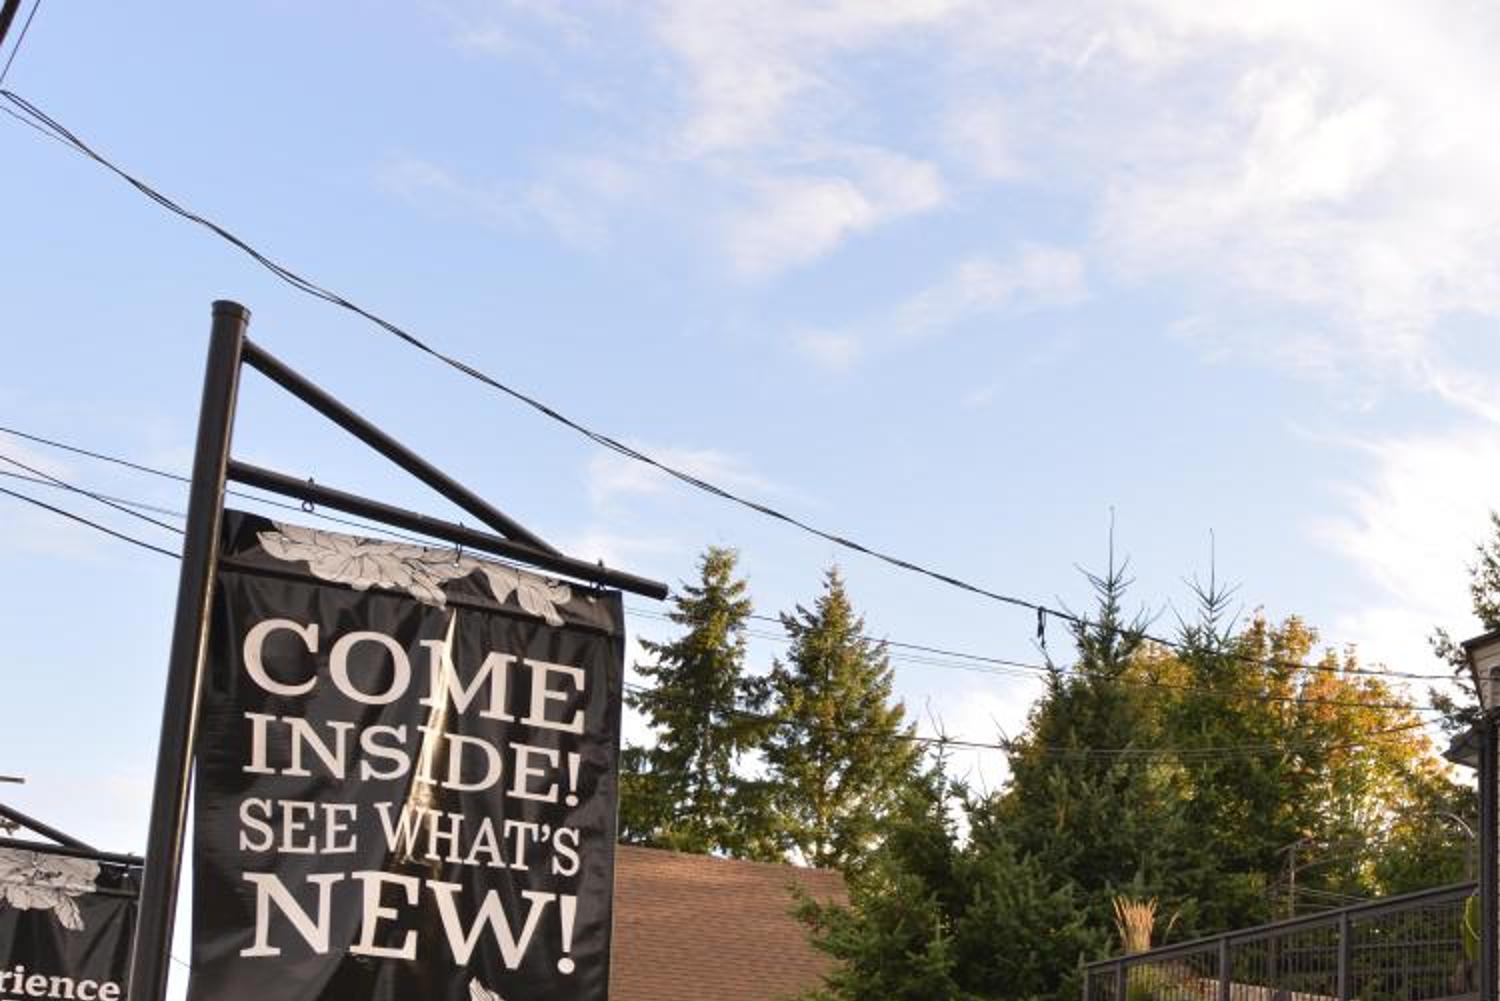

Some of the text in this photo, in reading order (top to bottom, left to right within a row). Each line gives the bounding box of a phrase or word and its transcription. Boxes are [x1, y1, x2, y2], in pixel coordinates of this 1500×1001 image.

[242, 619, 586, 734] COME
[242, 712, 582, 807] INSIDE!
[239, 799, 580, 876] SEE WHAT'S
[240, 871, 577, 974] NEW!
